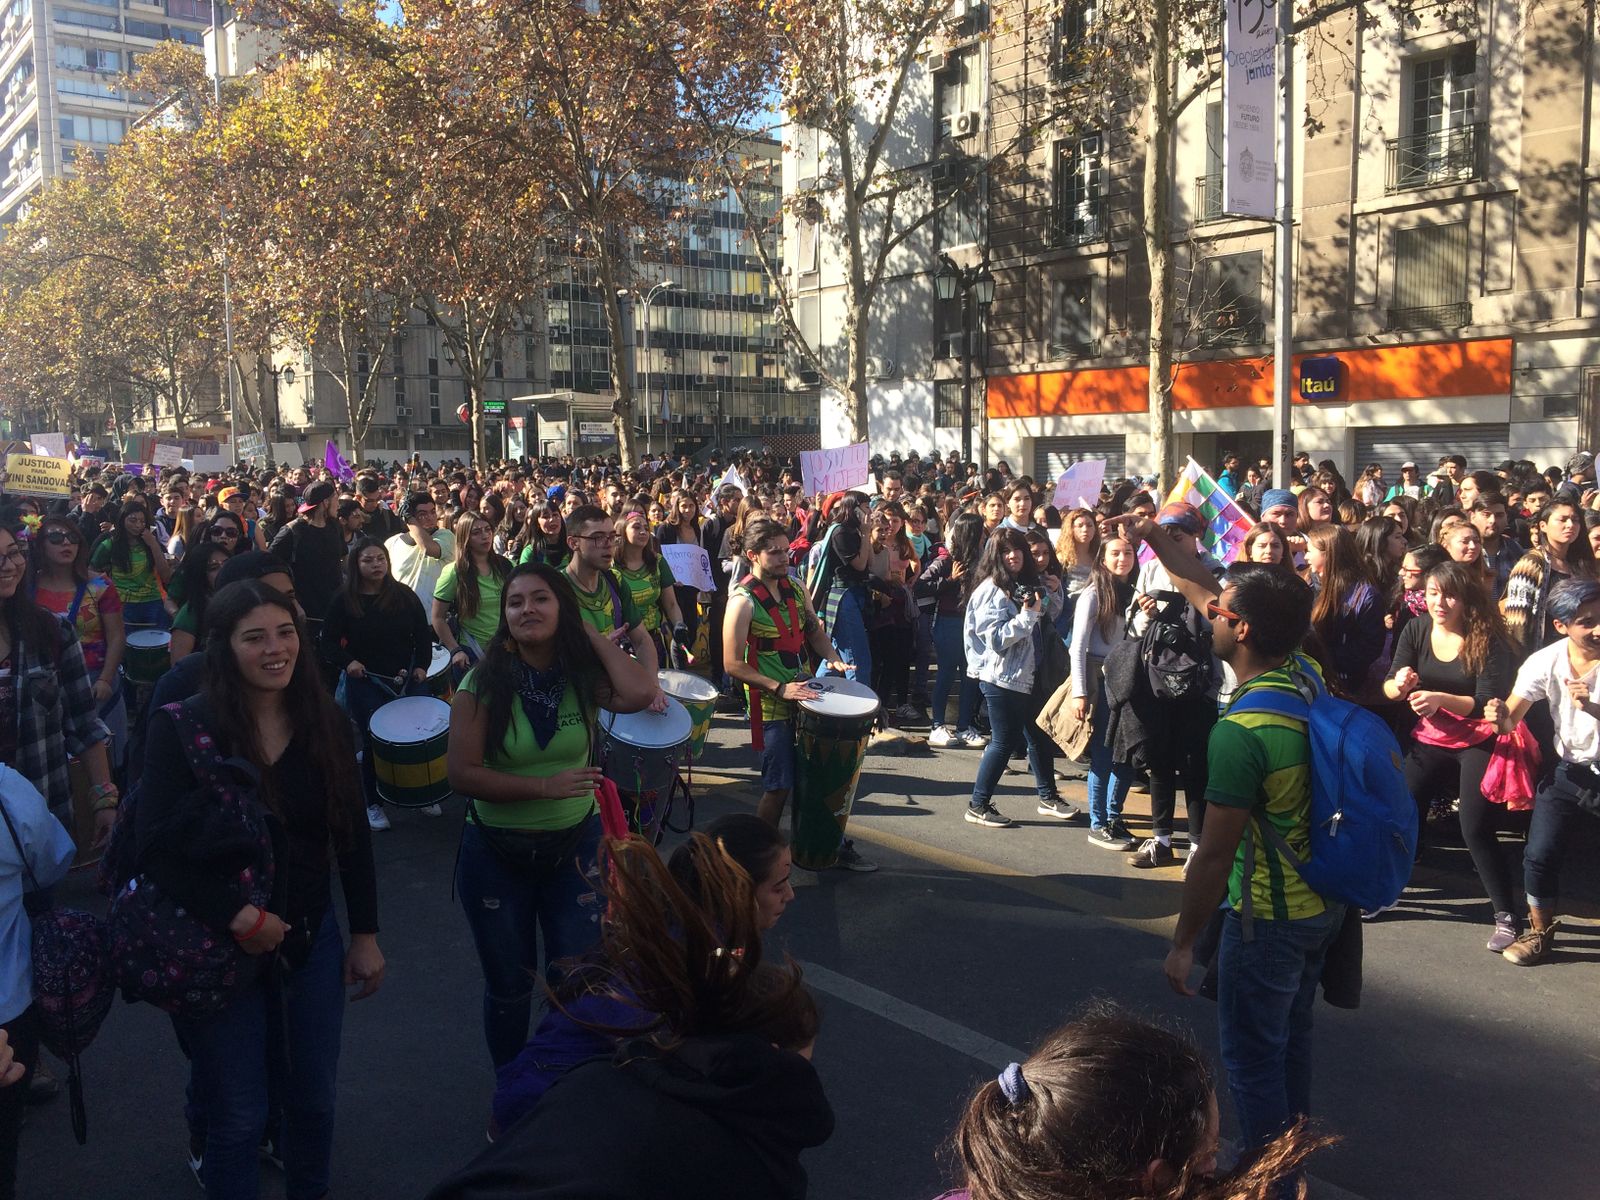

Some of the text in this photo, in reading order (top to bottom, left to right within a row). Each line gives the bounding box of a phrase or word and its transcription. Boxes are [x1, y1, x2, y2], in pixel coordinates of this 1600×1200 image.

[1301, 377, 1335, 393] Itaú
[18, 458, 61, 470] JUSTICIA
[26, 475, 71, 487] SANDOVAL
